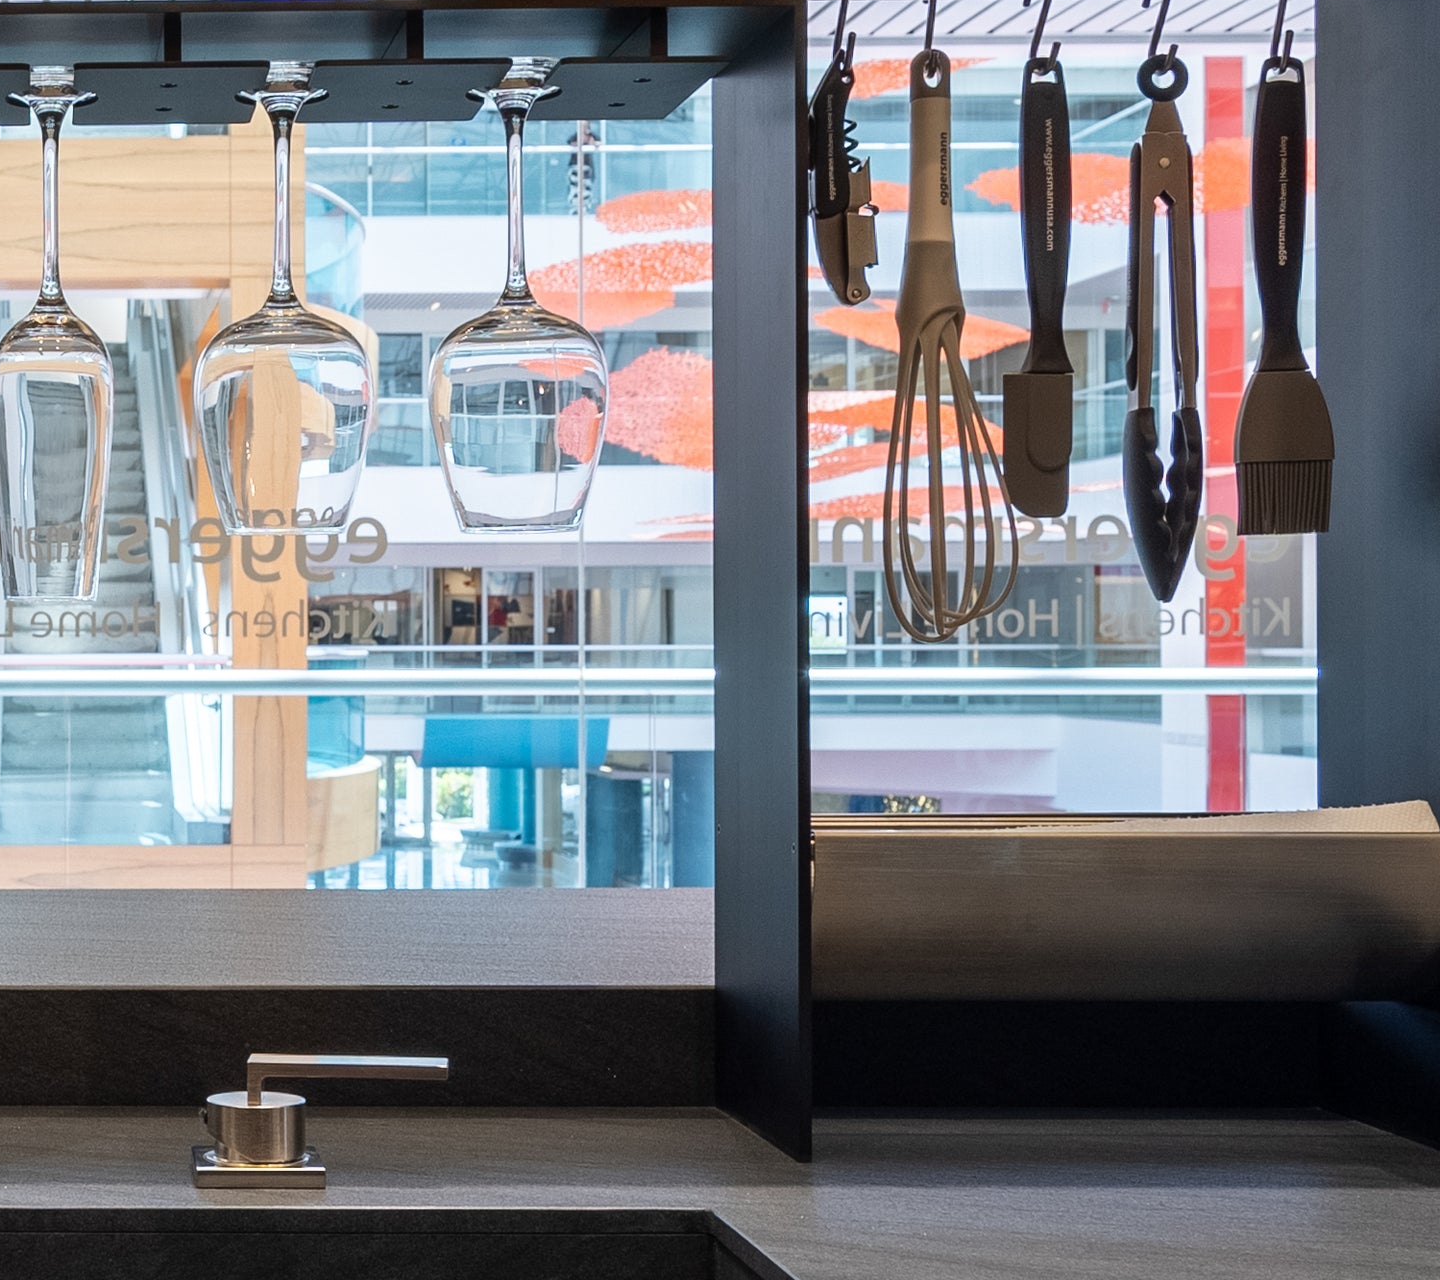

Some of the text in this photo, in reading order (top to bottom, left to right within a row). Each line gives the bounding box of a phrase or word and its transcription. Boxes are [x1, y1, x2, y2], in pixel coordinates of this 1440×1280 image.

[828, 157, 836, 201] eggersmann
[940, 132, 949, 206] eggersmann
[1043, 118, 1054, 252] www.eggersmannusa.com
[1278, 135, 1289, 266] eggersmann Kitchens Home Living
